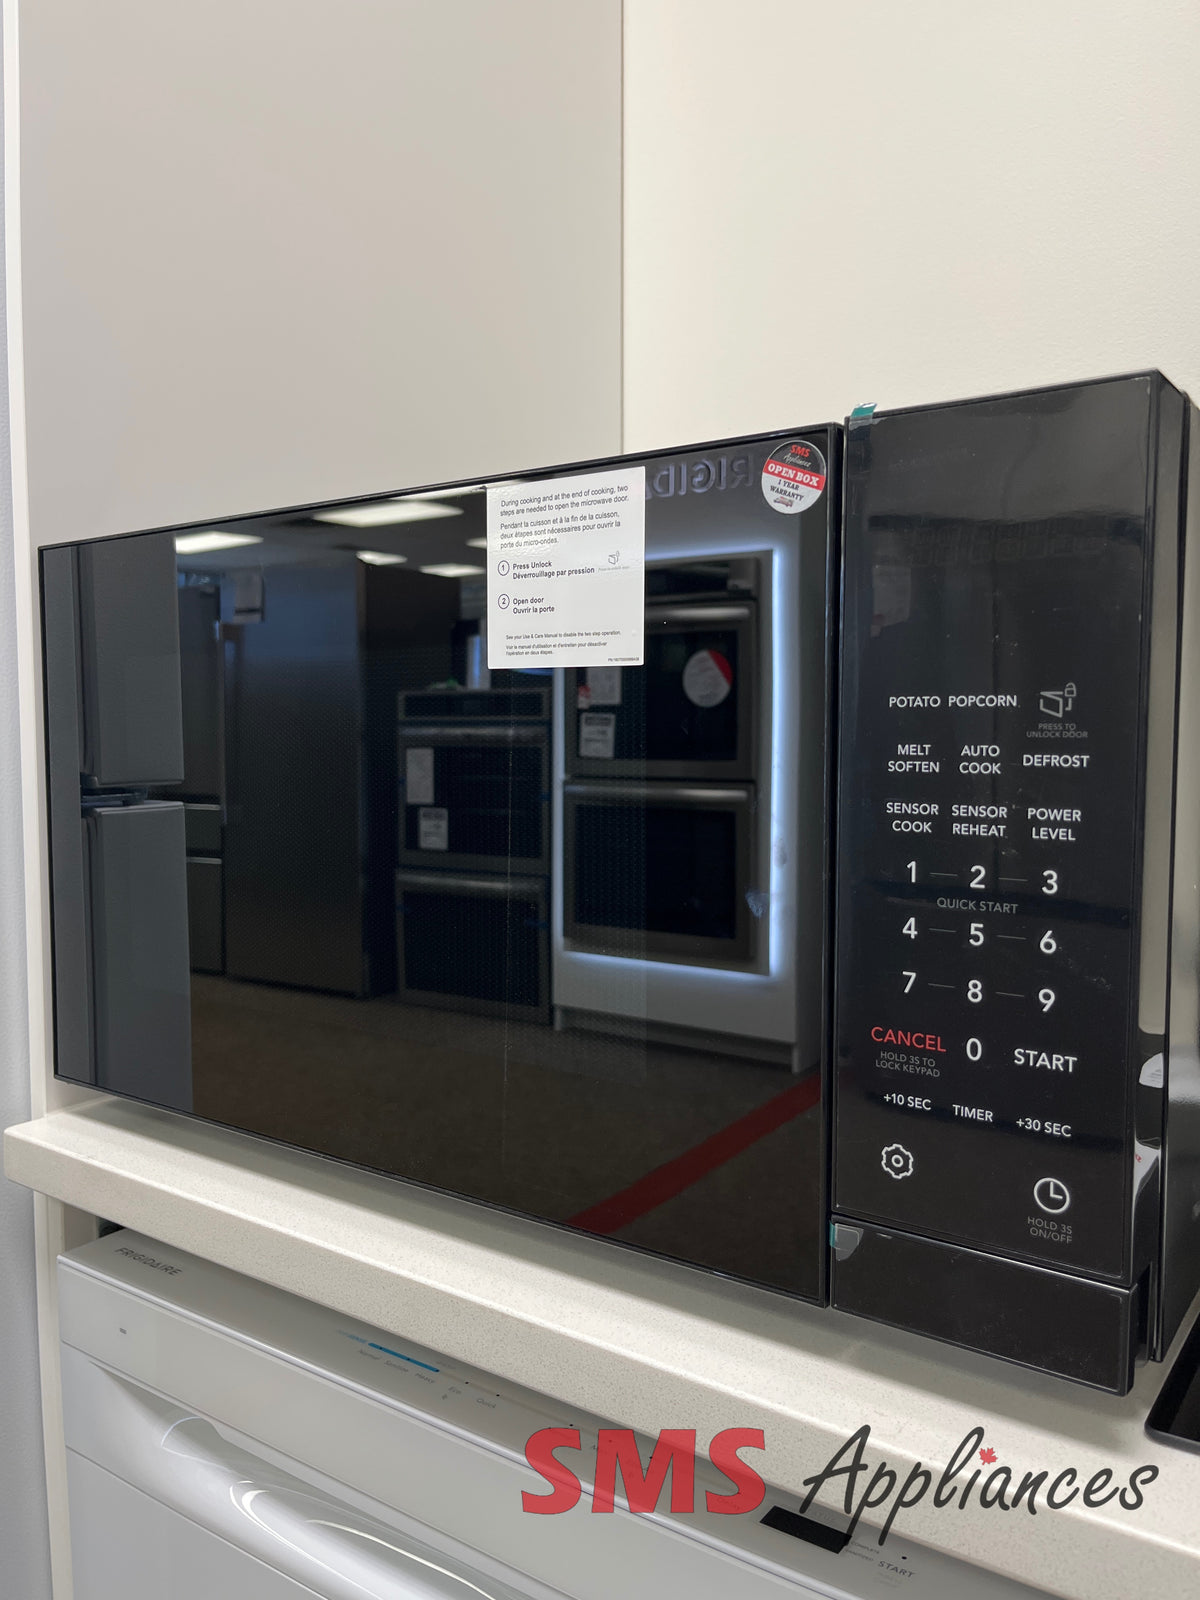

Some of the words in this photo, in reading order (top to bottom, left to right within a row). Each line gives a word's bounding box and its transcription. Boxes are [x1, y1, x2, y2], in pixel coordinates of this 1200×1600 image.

[791, 444, 811, 457] SMS
[768, 463, 796, 479] OPEN
[796, 472, 819, 486] BOX
[770, 485, 804, 501] WARRANTY
[783, 481, 800, 490] YEAR
[501, 500, 519, 508] During
[520, 497, 541, 505] cooking
[591, 487, 616, 496] cooking,
[526, 505, 546, 513] needed
[555, 502, 569, 510] open
[570, 500, 580, 508] the
[581, 497, 612, 506] microwave
[614, 495, 629, 503] door.
[501, 521, 522, 530] Pendant
[595, 511, 619, 519] cuisson,
[514, 530, 532, 539] étapes
[534, 528, 546, 536] sont
[547, 525, 581, 534] nécessaires
[582, 524, 596, 532] pour
[597, 521, 613, 529] ouvrir
[500, 541, 514, 549] porte
[513, 571, 555, 580] Déverrouillage
[556, 569, 567, 577] par
[568, 567, 595, 576] pression
[513, 598, 528, 606] Open
[539, 606, 555, 614] porte
[889, 696, 941, 708] POTATO
[948, 694, 1017, 706] POPCORN
[897, 744, 931, 756] MELT
[960, 745, 1000, 757] AUTO
[888, 760, 940, 773] SOFTEN
[959, 762, 1001, 775] COOK
[1023, 754, 1089, 768] DEFROST
[886, 802, 939, 815] SENSOR
[952, 804, 1007, 818] SENSOR
[1027, 808, 1082, 822] POWER
[892, 820, 932, 833] COOK
[952, 824, 1006, 837] REHEAT
[1032, 827, 1076, 841] LEVEL
[906, 861, 916, 883] 1
[969, 865, 986, 889] 2
[1041, 870, 1058, 895] 3
[937, 897, 976, 911] QUICK
[979, 901, 1019, 914] START
[902, 917, 918, 939] 4
[969, 923, 984, 946] 5
[1040, 930, 1056, 954] 6
[902, 972, 917, 993] 7
[967, 980, 982, 1003] 8
[1038, 989, 1055, 1012] 9
[871, 1026, 946, 1052] CANCEL
[966, 1038, 982, 1061] 0
[880, 1051, 907, 1062] HOLD
[910, 1056, 919, 1064] 3S
[922, 1058, 936, 1067] TO
[1014, 1048, 1078, 1072] START
[875, 1060, 900, 1070] LOCK
[903, 1064, 940, 1077] KEYPAD
[884, 1093, 904, 1105] +10
[907, 1096, 931, 1111] SEC
[952, 1105, 993, 1123] TIMER
[1016, 1118, 1041, 1131] +30
[1044, 1122, 1072, 1137] SEC
[1027, 1216, 1058, 1230] HOLD
[1061, 1224, 1072, 1234] 3S
[1030, 1227, 1072, 1244] ON/OFF
[114, 1247, 182, 1276] FRIGIDAIRE
[878, 1560, 916, 1578] START
